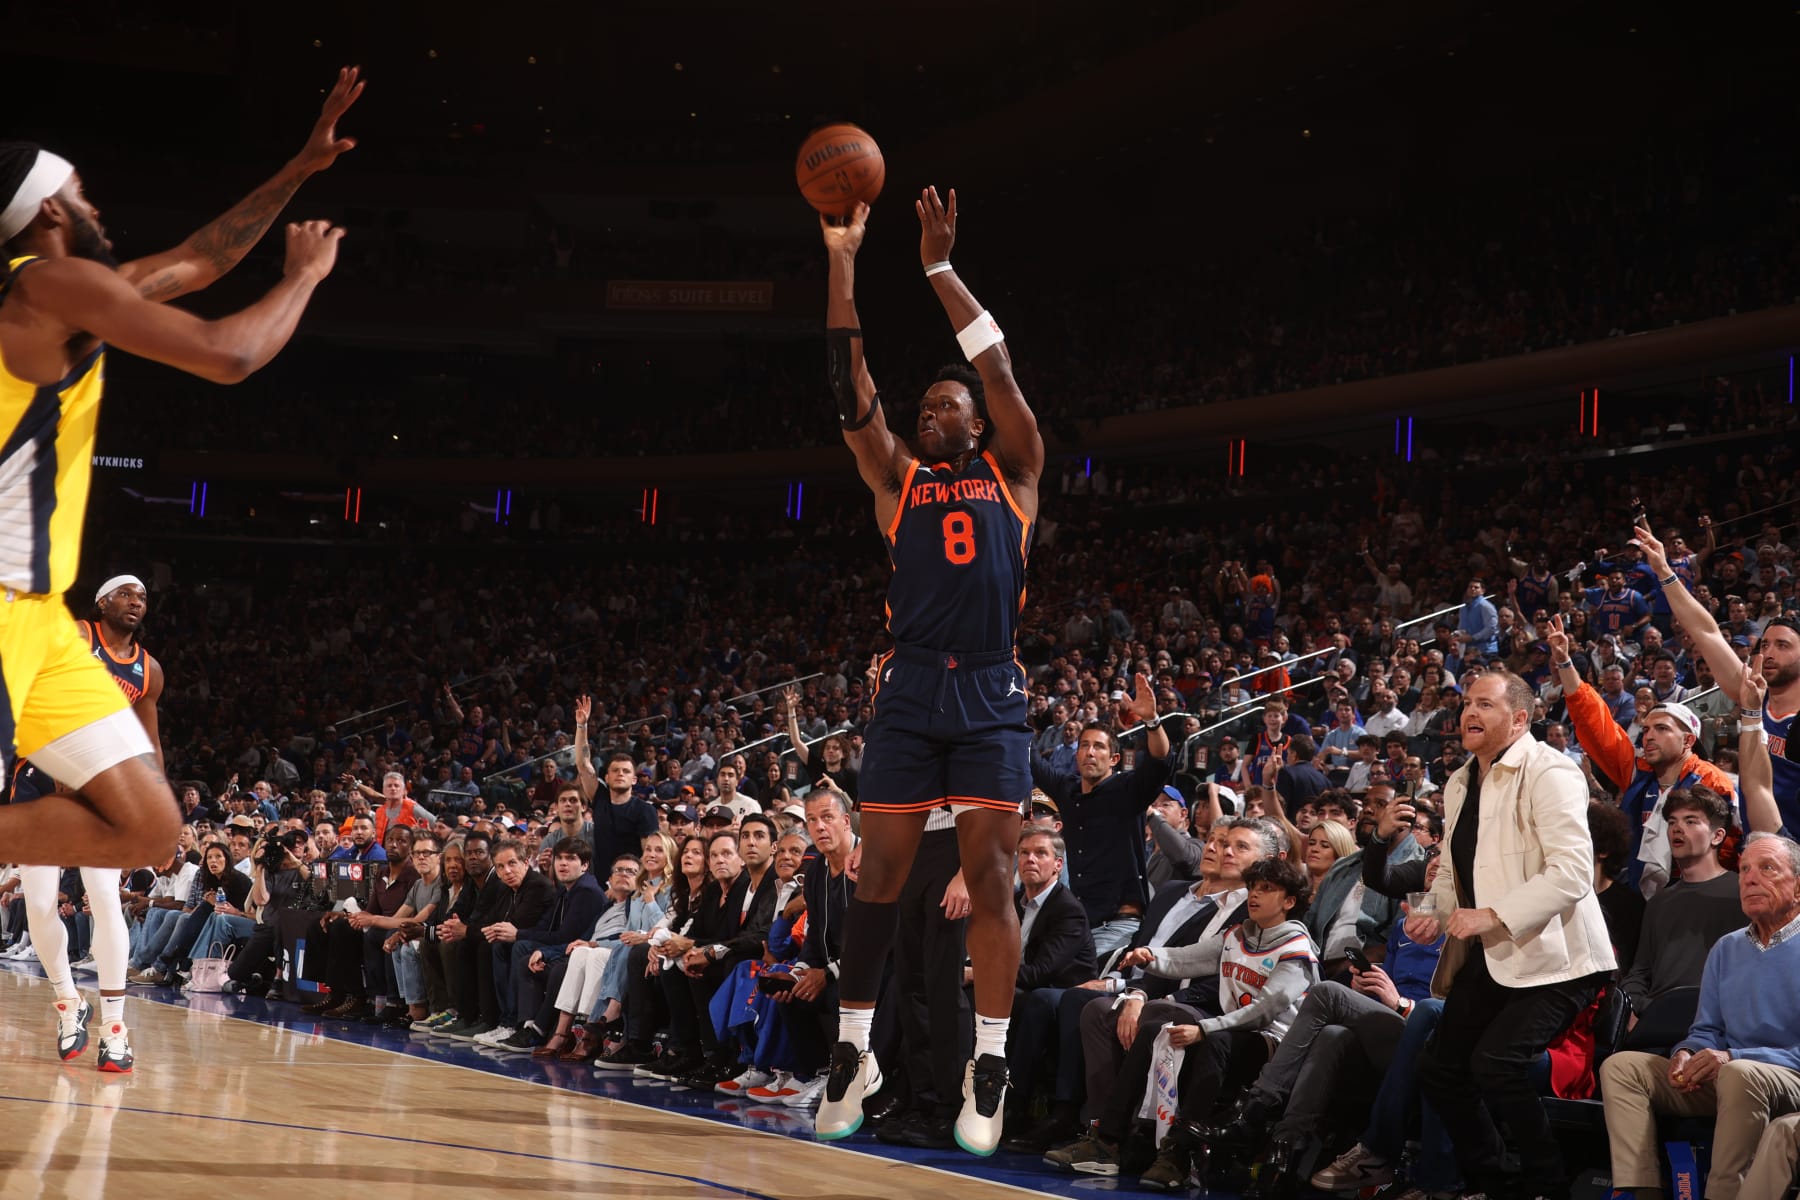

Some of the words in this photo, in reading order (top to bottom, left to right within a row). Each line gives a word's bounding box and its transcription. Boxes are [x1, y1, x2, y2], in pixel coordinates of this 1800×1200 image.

[804, 141, 862, 172] Wilson
[669, 287, 713, 304] SUITE
[719, 288, 768, 305] LEVEL
[92, 455, 144, 469] NYKNICKS
[910, 481, 950, 509] NEW
[949, 479, 1001, 504] YORK
[942, 510, 977, 566] 8
